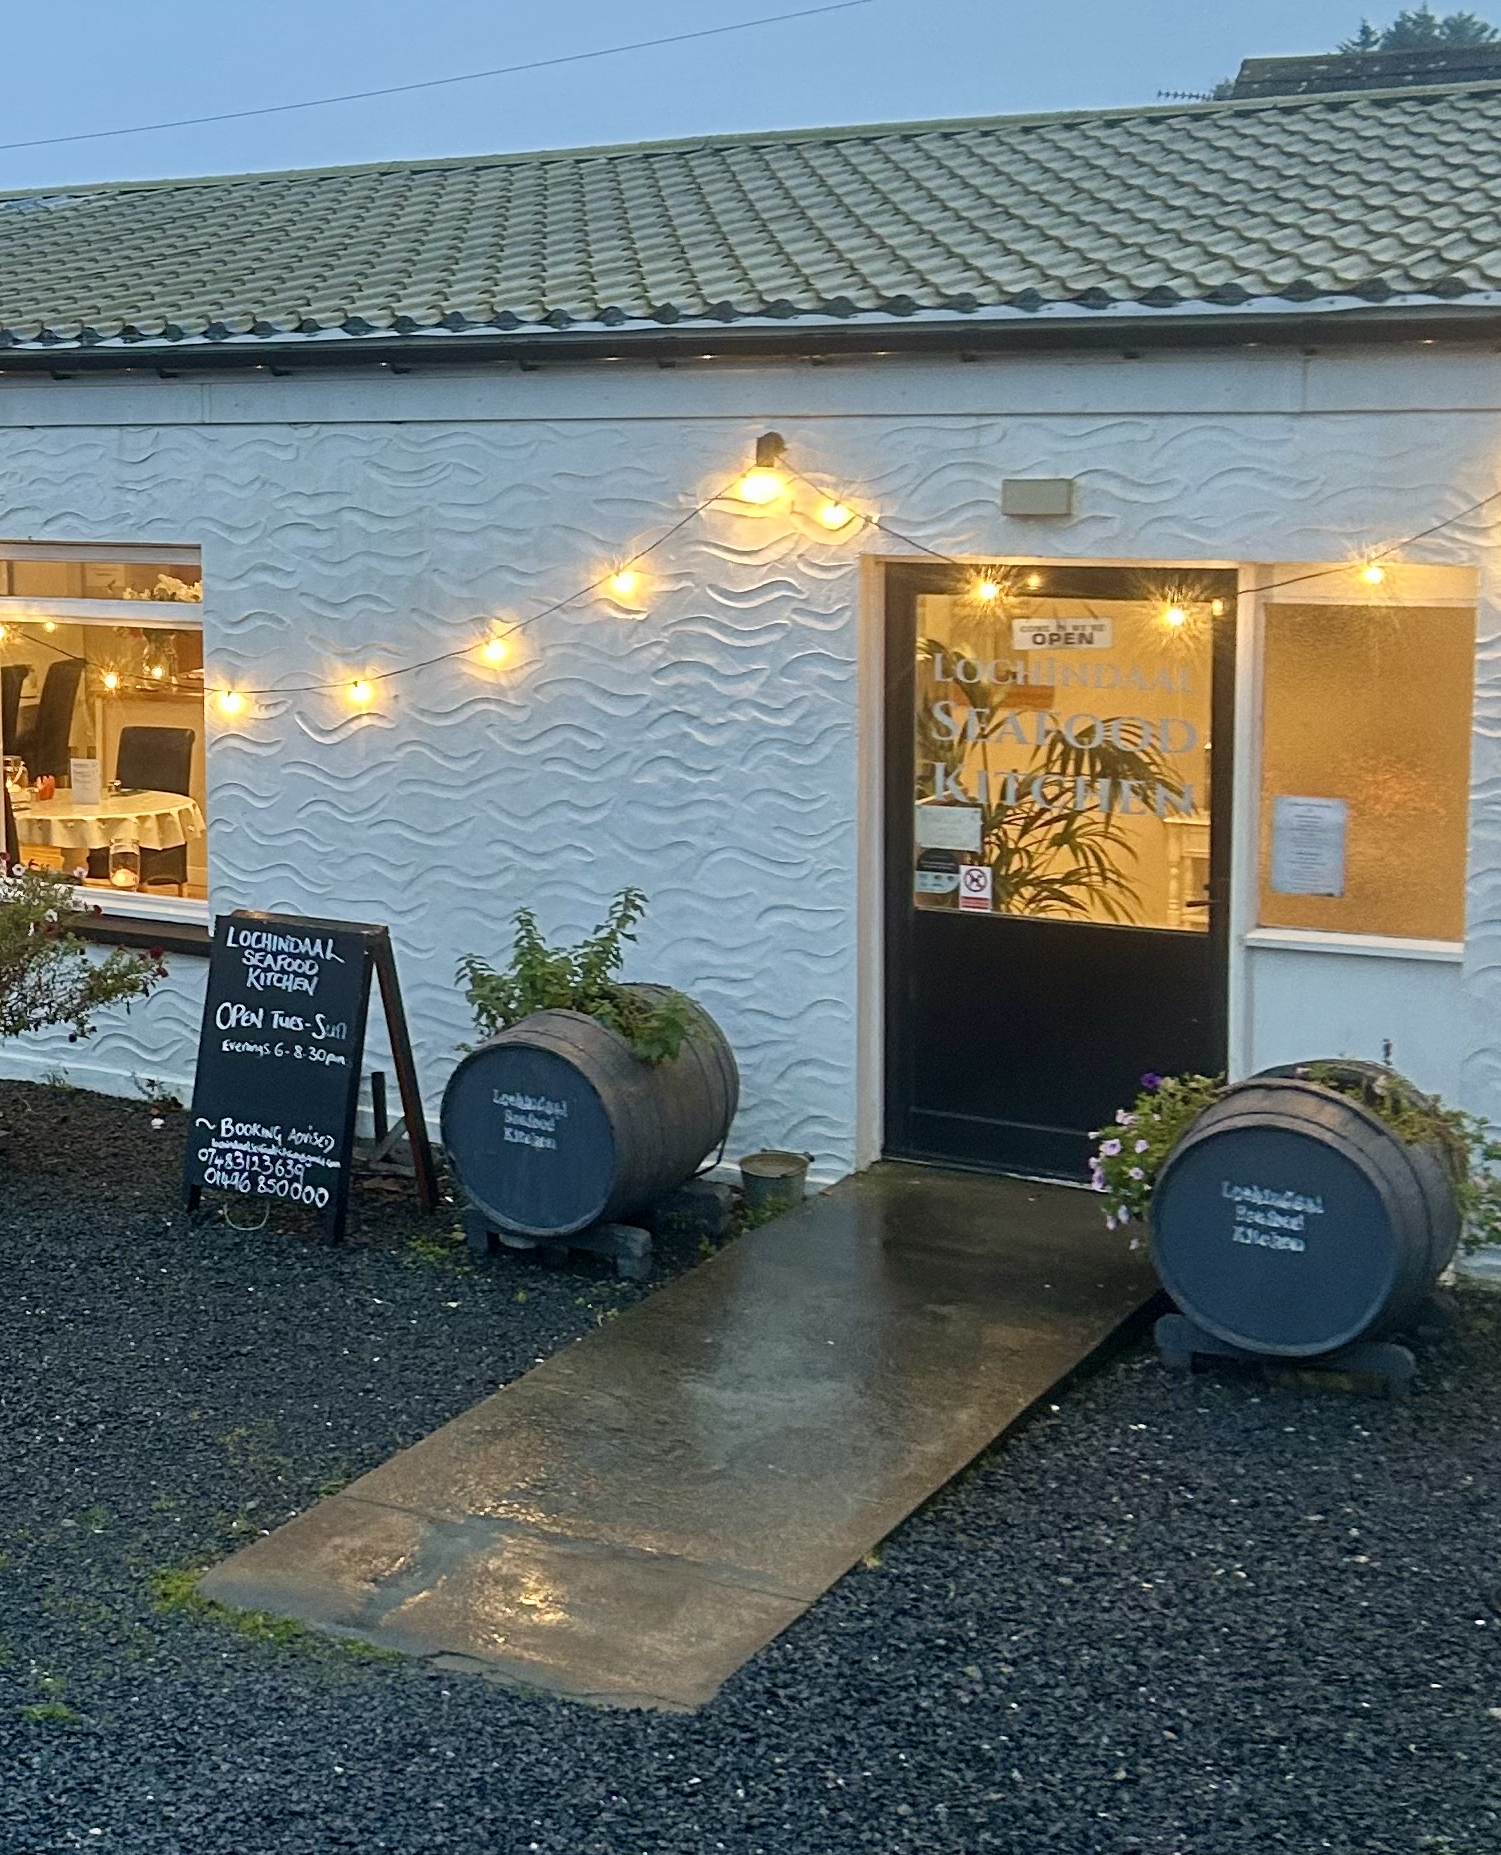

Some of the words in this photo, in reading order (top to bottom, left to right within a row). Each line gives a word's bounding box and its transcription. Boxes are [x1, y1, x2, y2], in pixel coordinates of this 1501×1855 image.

[1032, 632, 1094, 645] OPEN
[932, 651, 1195, 695] LOCHINDAAL
[931, 700, 1198, 754] SEAFOOD
[932, 761, 1195, 818] KITCHEN
[226, 925, 345, 963] LOCHINDAAL
[241, 949, 319, 975] SEAFOOD
[246, 966, 319, 996] KITCHEN
[215, 1001, 264, 1030] OPEN
[220, 1117, 282, 1147] BOOKING
[203, 1166, 252, 1193] 01496
[257, 1174, 329, 1208] 850000
